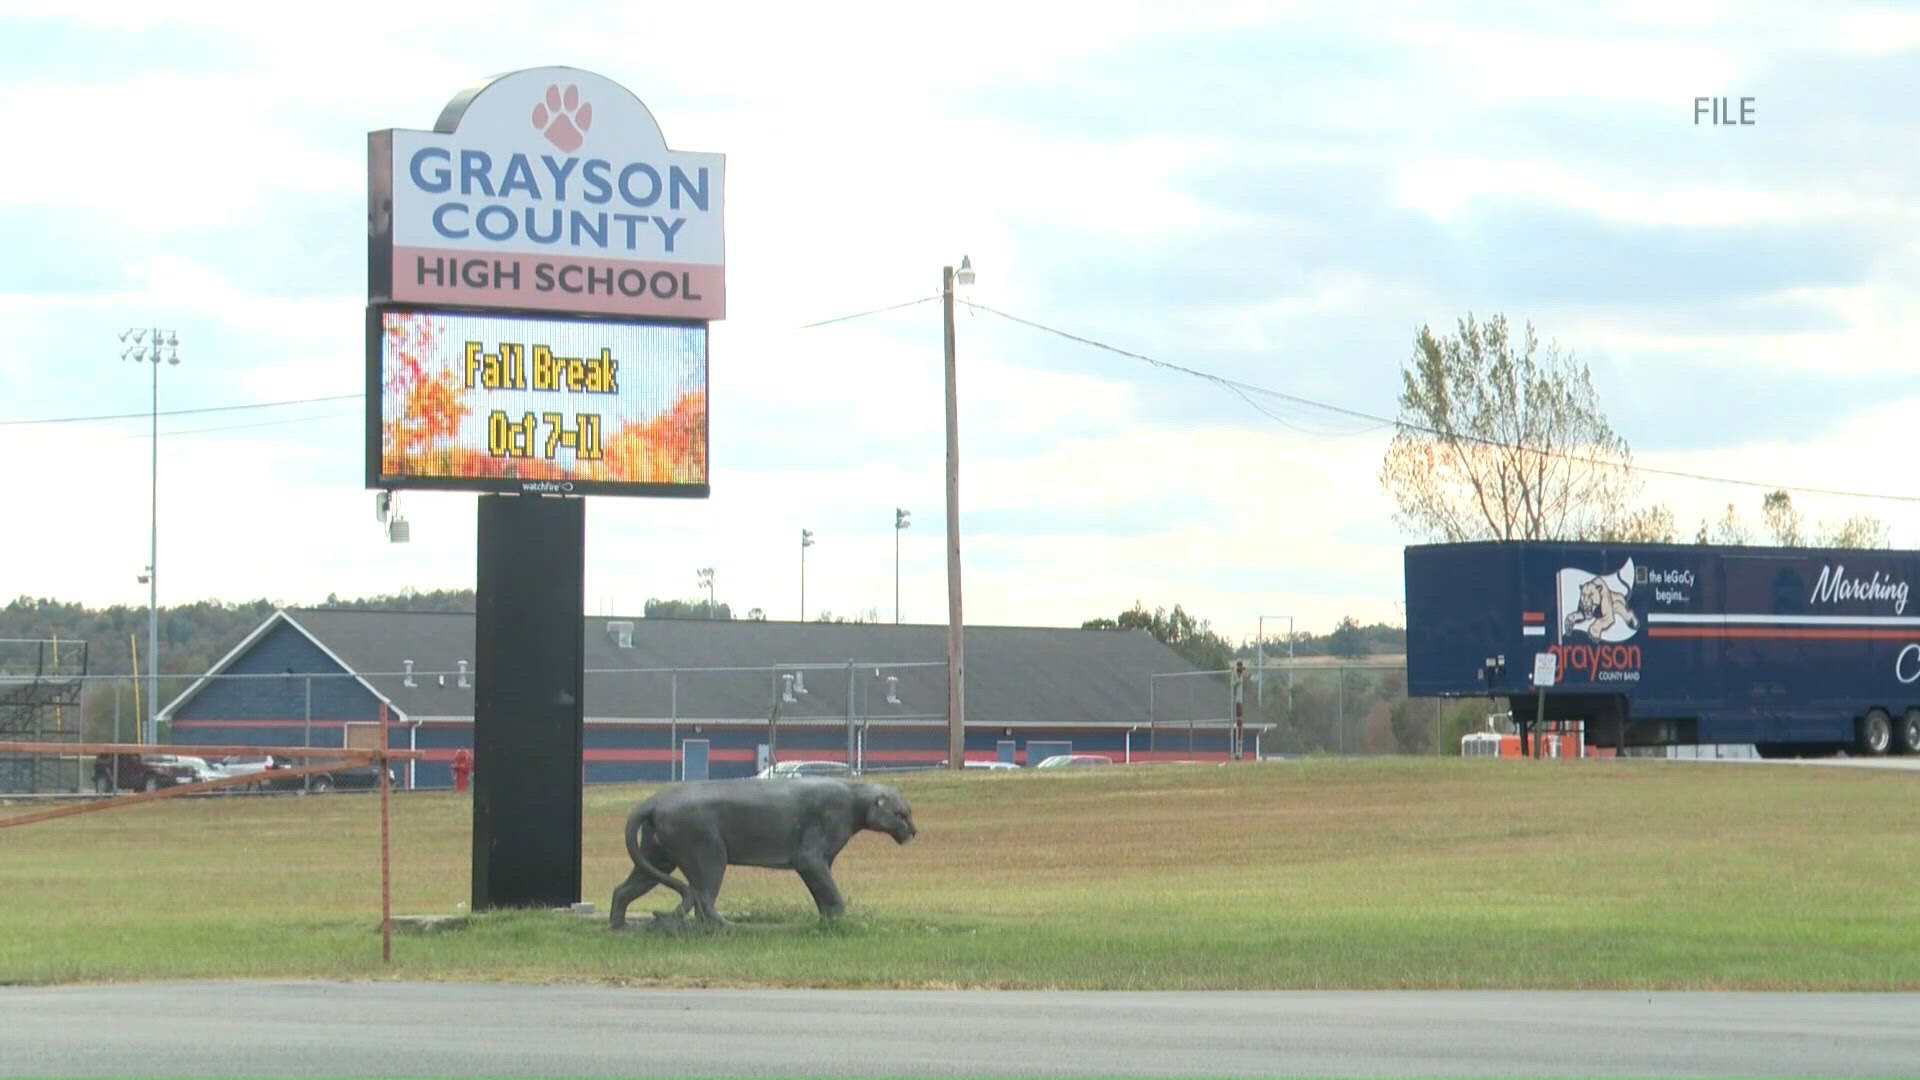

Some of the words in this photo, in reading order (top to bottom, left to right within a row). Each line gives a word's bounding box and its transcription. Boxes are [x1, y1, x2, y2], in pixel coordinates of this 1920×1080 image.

[409, 147, 708, 211] GRAYSON
[432, 202, 687, 252] COUNTY
[417, 256, 520, 290] HIGH
[535, 265, 702, 301] SCHOOL
[465, 341, 527, 389] Fall
[532, 344, 618, 394] Break
[488, 410, 537, 459] Oct
[543, 412, 603, 460] 7-11
[522, 482, 560, 492] watchfire
[1649, 569, 1662, 583] the
[1810, 565, 1909, 614] Marching
[1599, 671, 1623, 681] COUNTY
[1624, 671, 1641, 681] BAND
